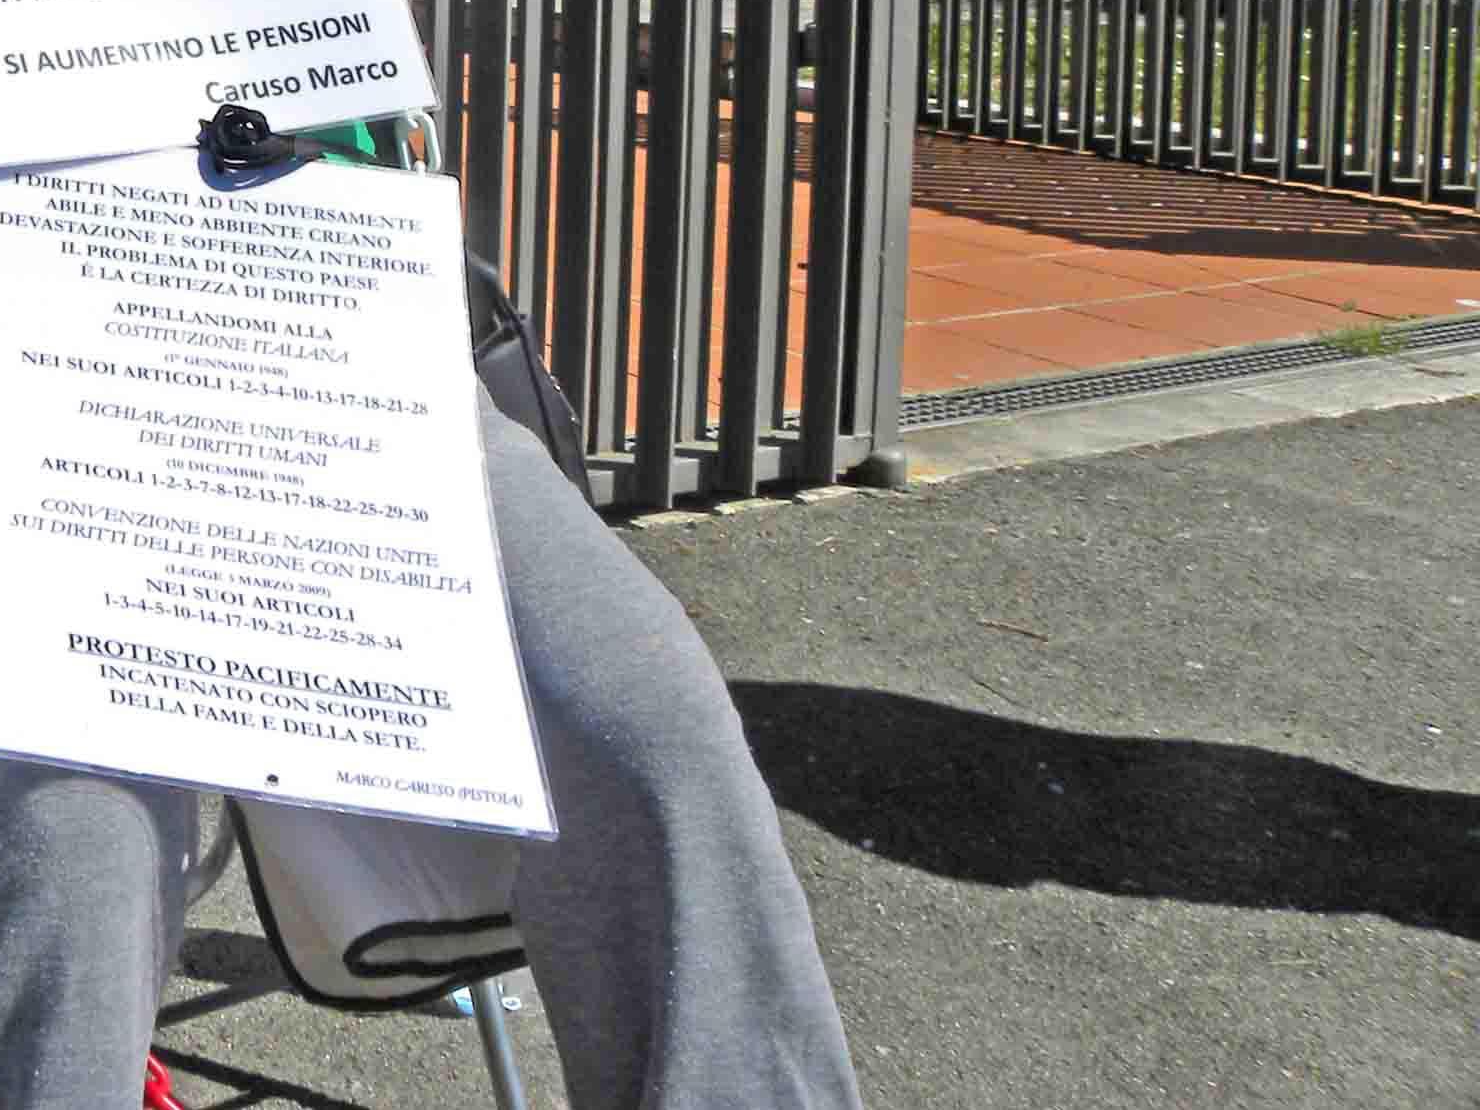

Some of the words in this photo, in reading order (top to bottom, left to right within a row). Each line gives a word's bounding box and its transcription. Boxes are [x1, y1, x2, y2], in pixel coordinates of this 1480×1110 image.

[3, 53, 28, 74] SI
[38, 37, 203, 71] AUMENTINO
[210, 32, 240, 55] LE
[245, 12, 371, 50] PENSIONI
[205, 76, 301, 104] Caruso
[306, 60, 398, 90] Marco
[25, 171, 104, 196] DIRITTI
[111, 184, 188, 206] NEGATI
[198, 195, 223, 210] AD
[228, 197, 258, 214] UN
[264, 201, 422, 234] DIVERSAMENTE
[45, 197, 106, 217] ABILE
[112, 205, 125, 219] E
[130, 207, 194, 226] MENO
[200, 217, 303, 240] ABBIENTE
[308, 228, 391, 249] CREANO
[0, 211, 156, 244] DEVASTAZIONE
[163, 233, 176, 246] E
[181, 235, 314, 263] SOFFERENZA
[61, 241, 80, 255] IL
[87, 243, 198, 270] PROBLEMA
[204, 258, 225, 274] DI
[232, 262, 314, 283] QUESTO
[319, 272, 379, 290] PAESE
[99, 266, 125, 282] LA
[130, 271, 238, 296] CERTEZZA
[244, 284, 265, 299] DI
[104, 321, 246, 351] COSTITUZIONE
[253, 339, 348, 364] ITALIANA
[113, 301, 276, 334] APPELLANDOMI
[284, 323, 332, 340] ALLA
[21, 350, 59, 368] NEI
[66, 357, 116, 375] SUOI
[123, 365, 221, 390] ARTICOLI
[79, 400, 243, 434] DICHIARAZIONE
[250, 423, 380, 452] UNIVERSALE
[139, 429, 174, 447] DEI
[180, 435, 252, 458] DIRITTI
[259, 445, 327, 466] UMANI
[41, 457, 144, 484] ARTICOLI
[10, 513, 44, 530] SUI
[50, 519, 126, 545] DIRITTI
[133, 533, 203, 557] DELLE
[211, 545, 304, 572] PERSONE
[311, 560, 353, 578] CON
[40, 498, 200, 534] CONVENZIONE
[207, 523, 276, 546] DELLE
[283, 534, 369, 559] NAZIONI
[376, 546, 438, 567] UNITE
[146, 577, 186, 597] NEI
[192, 586, 244, 607] SUOI
[253, 595, 355, 623] ARTICOLI
[67, 633, 217, 675] PROTESTO
[226, 660, 451, 709] PACIFICAMENTE
[99, 663, 253, 703] INCATENATO
[260, 690, 310, 712] CON
[316, 696, 428, 728] SCIOPERO
[109, 689, 187, 715] DELLA
[193, 703, 255, 727] FAME
[261, 715, 276, 730] E
[282, 718, 358, 743] DELLA
[336, 770, 391, 788] MARCO
